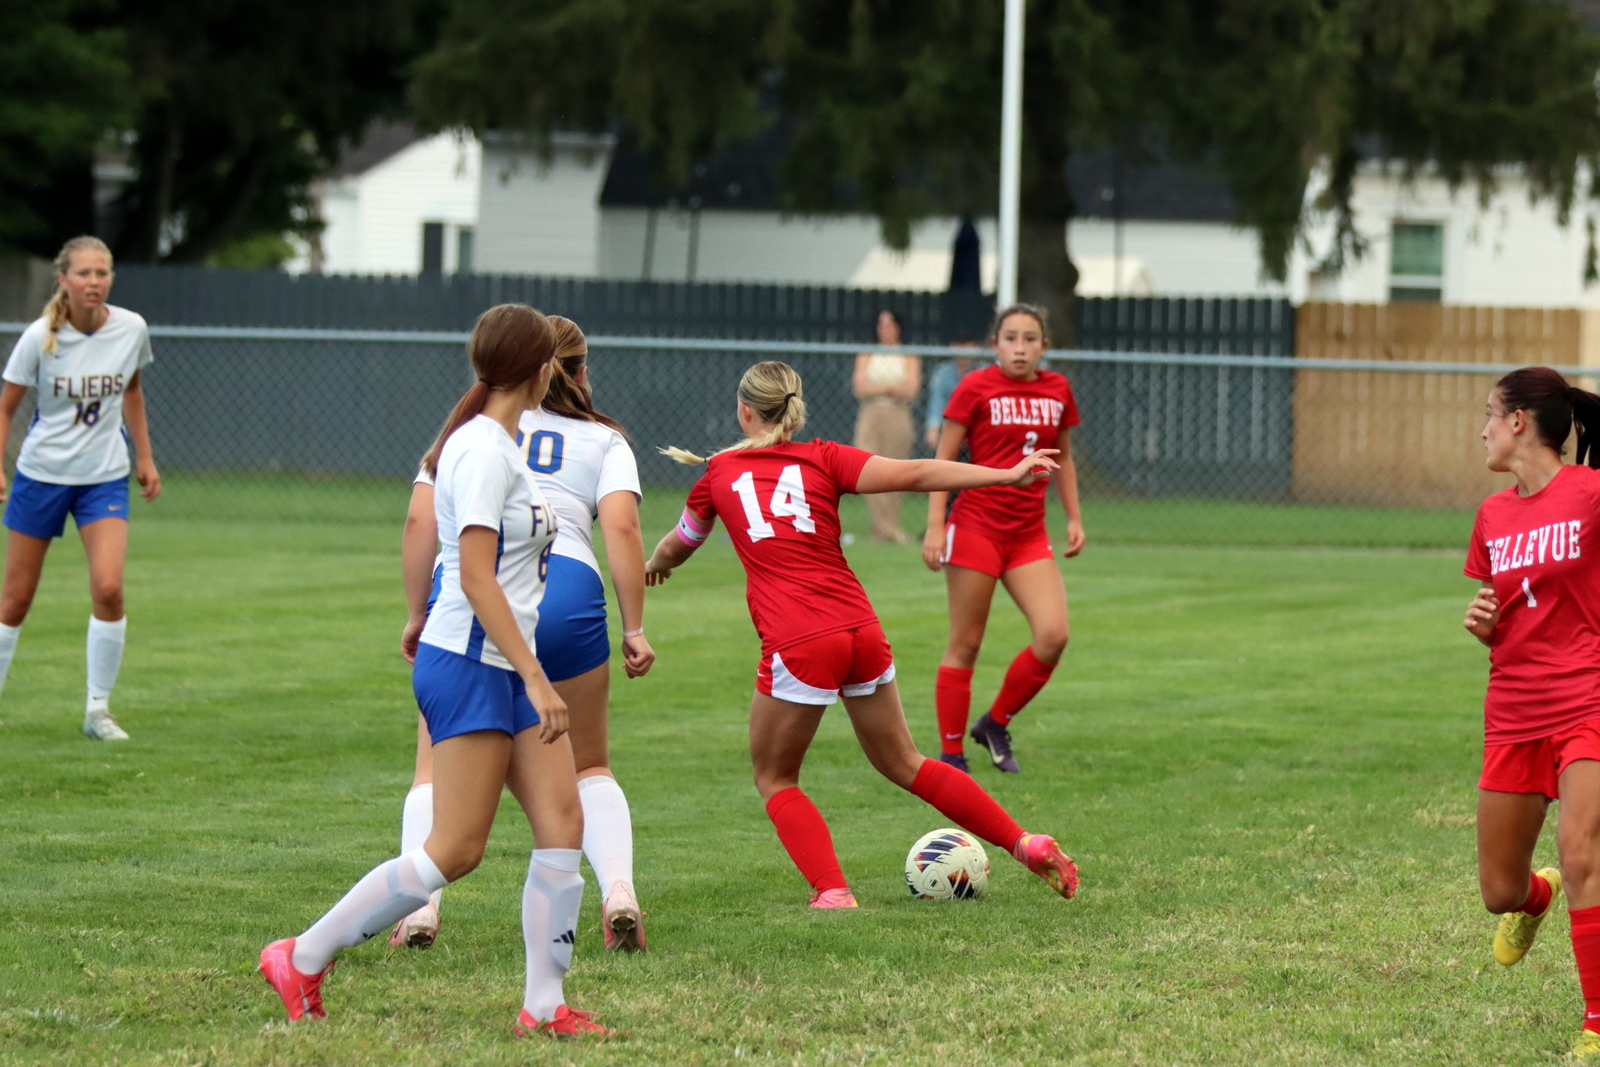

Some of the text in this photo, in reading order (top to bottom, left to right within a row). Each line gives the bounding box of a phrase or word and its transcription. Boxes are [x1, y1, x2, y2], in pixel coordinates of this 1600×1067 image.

[54, 373, 123, 398] FLIERS
[1022, 431, 1038, 456] 2
[731, 464, 816, 543] 14
[1486, 520, 1581, 575] BELLEVUE
[1522, 577, 1537, 608] 1
